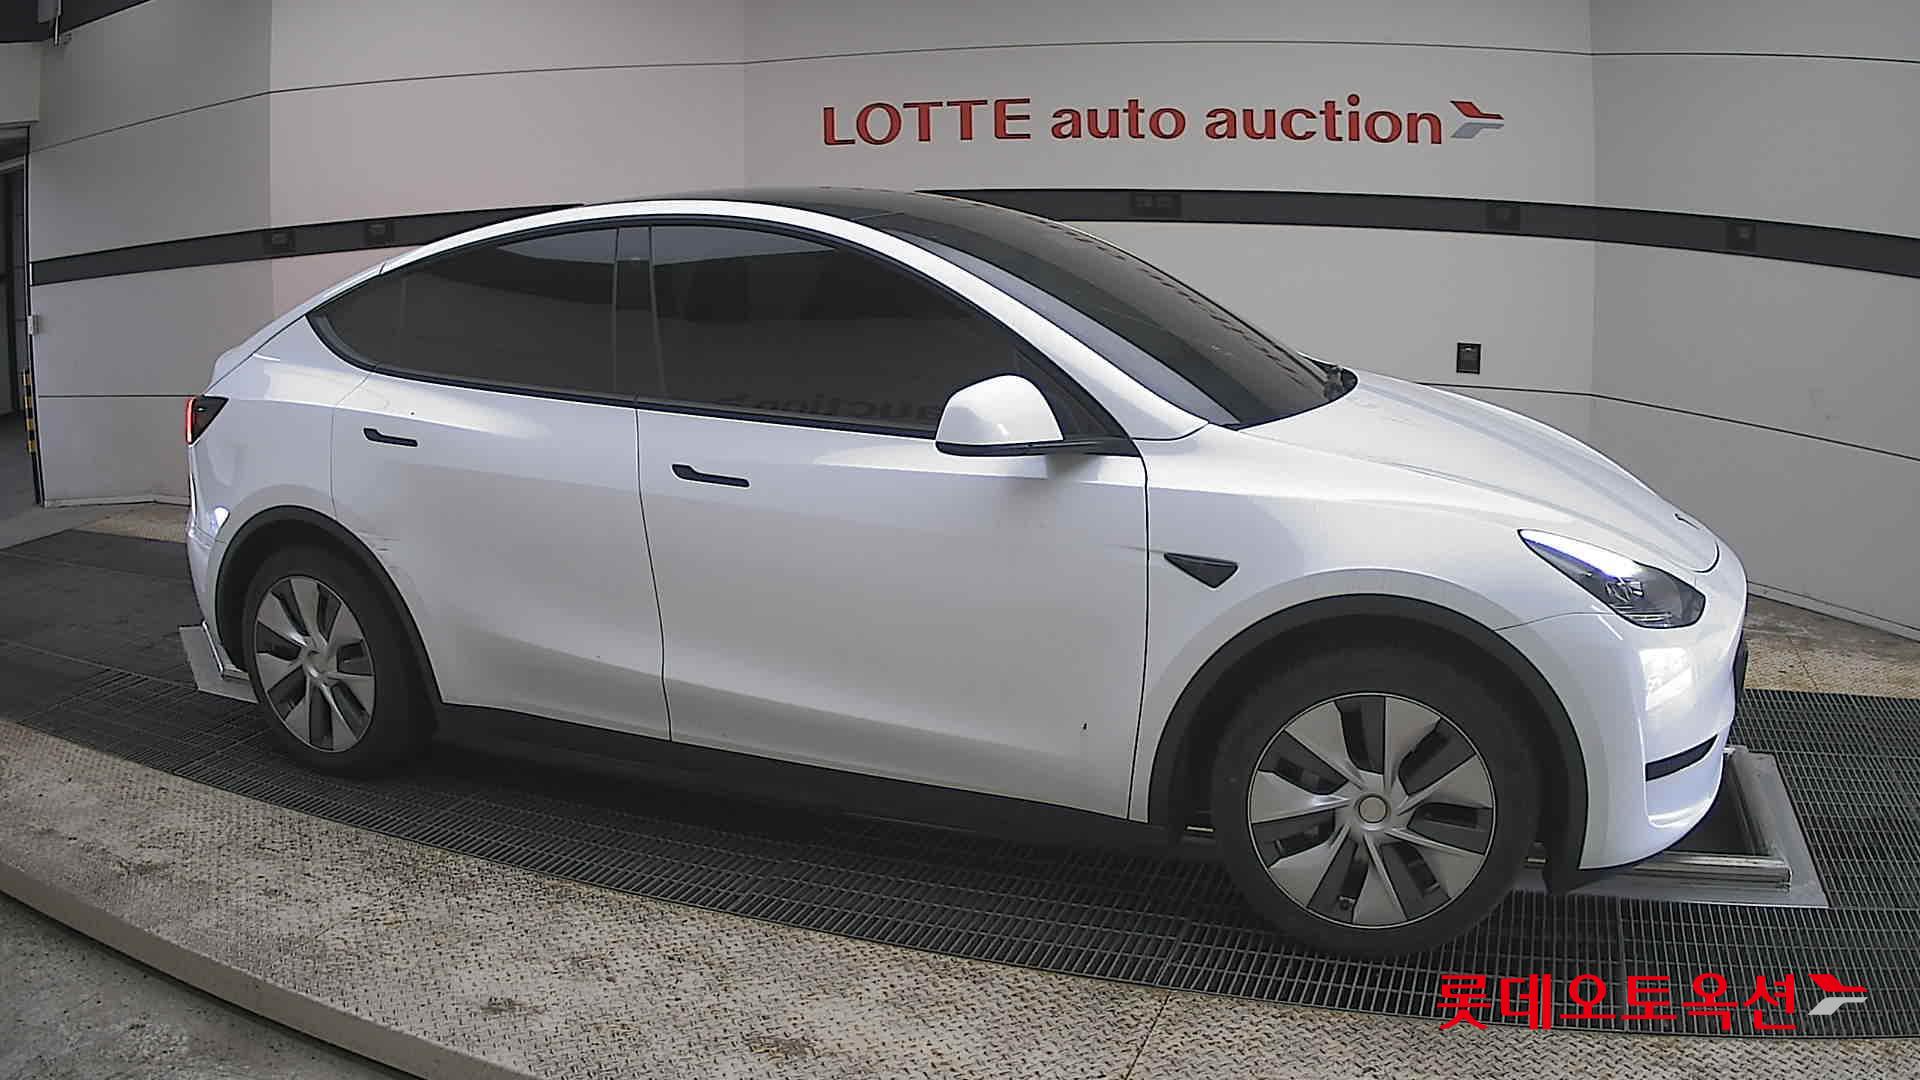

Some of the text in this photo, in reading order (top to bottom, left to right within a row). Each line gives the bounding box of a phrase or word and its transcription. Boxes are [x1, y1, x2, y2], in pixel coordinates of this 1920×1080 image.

[823, 94, 1442, 146] LOTTE auto auction
